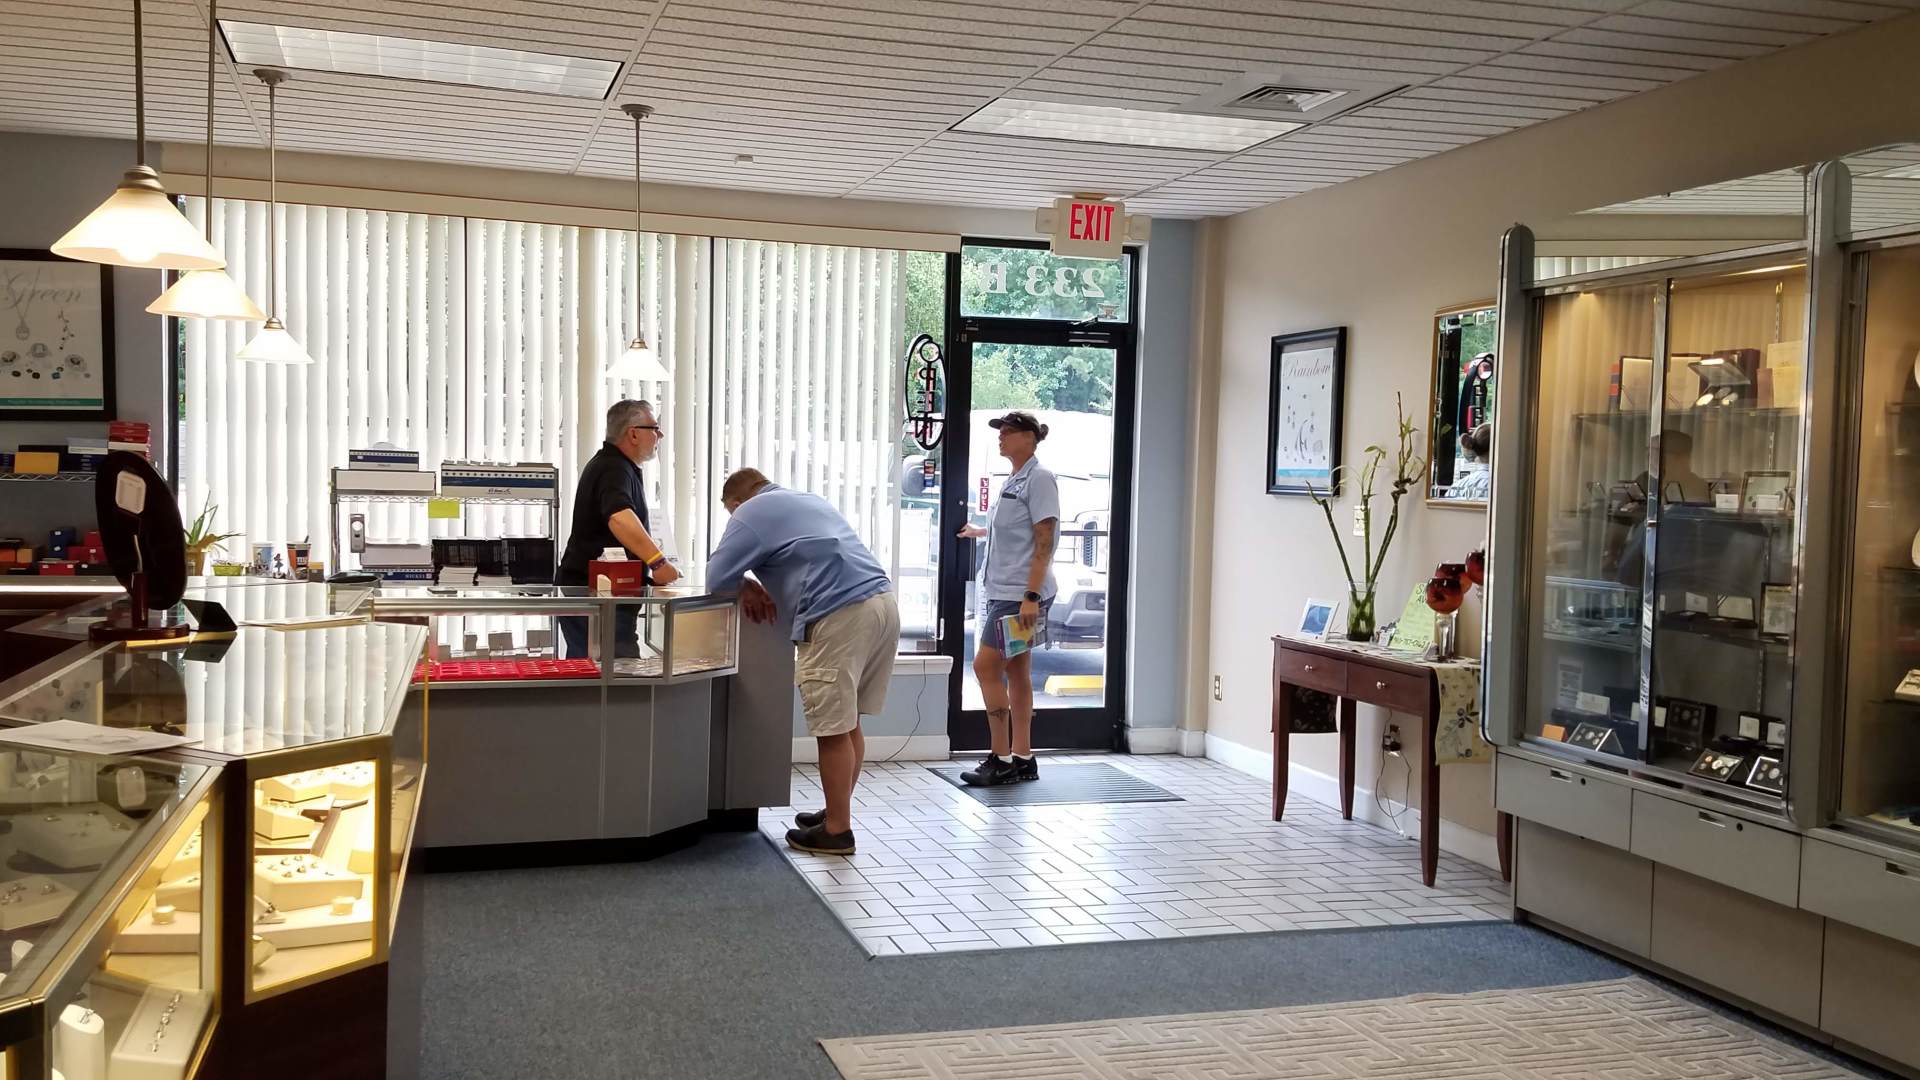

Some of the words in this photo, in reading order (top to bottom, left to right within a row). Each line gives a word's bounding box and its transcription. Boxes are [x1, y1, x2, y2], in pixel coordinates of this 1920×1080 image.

[1070, 203, 1115, 242] EXIT
[0, 271, 81, 311] Green
[1282, 358, 1332, 377] Rainbow
